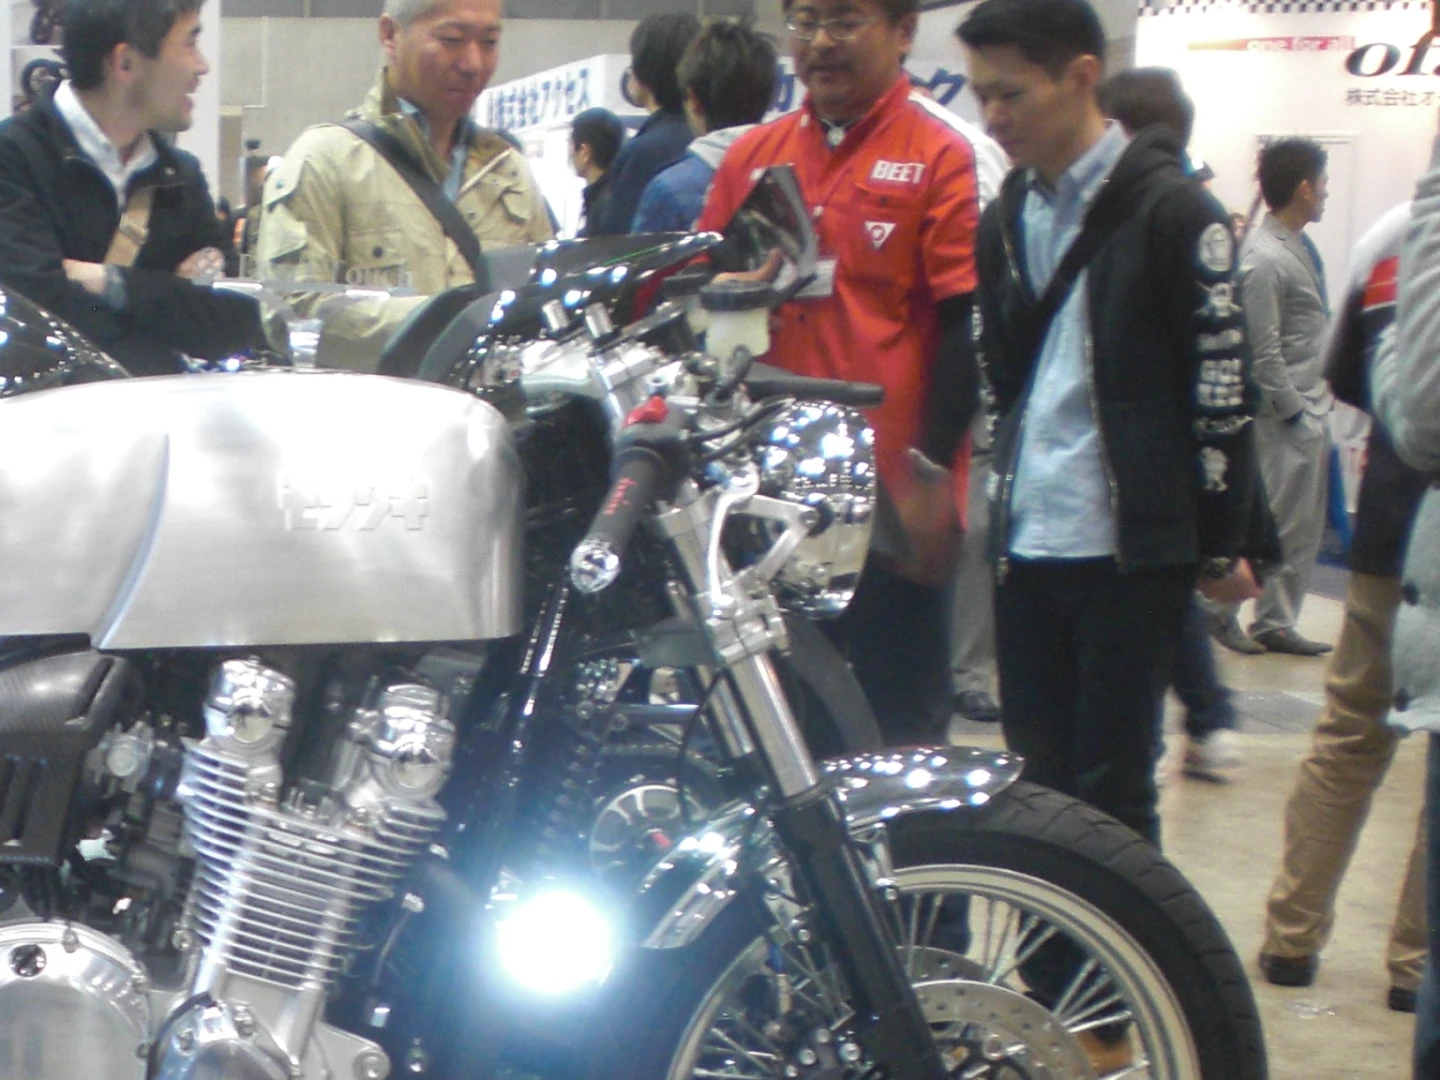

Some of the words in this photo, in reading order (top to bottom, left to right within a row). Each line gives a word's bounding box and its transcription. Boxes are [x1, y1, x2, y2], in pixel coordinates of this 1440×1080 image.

[1344, 30, 1440, 78] of
[1346, 88, 1440, 107] 株式会社オ
[870, 159, 926, 184] BEET
